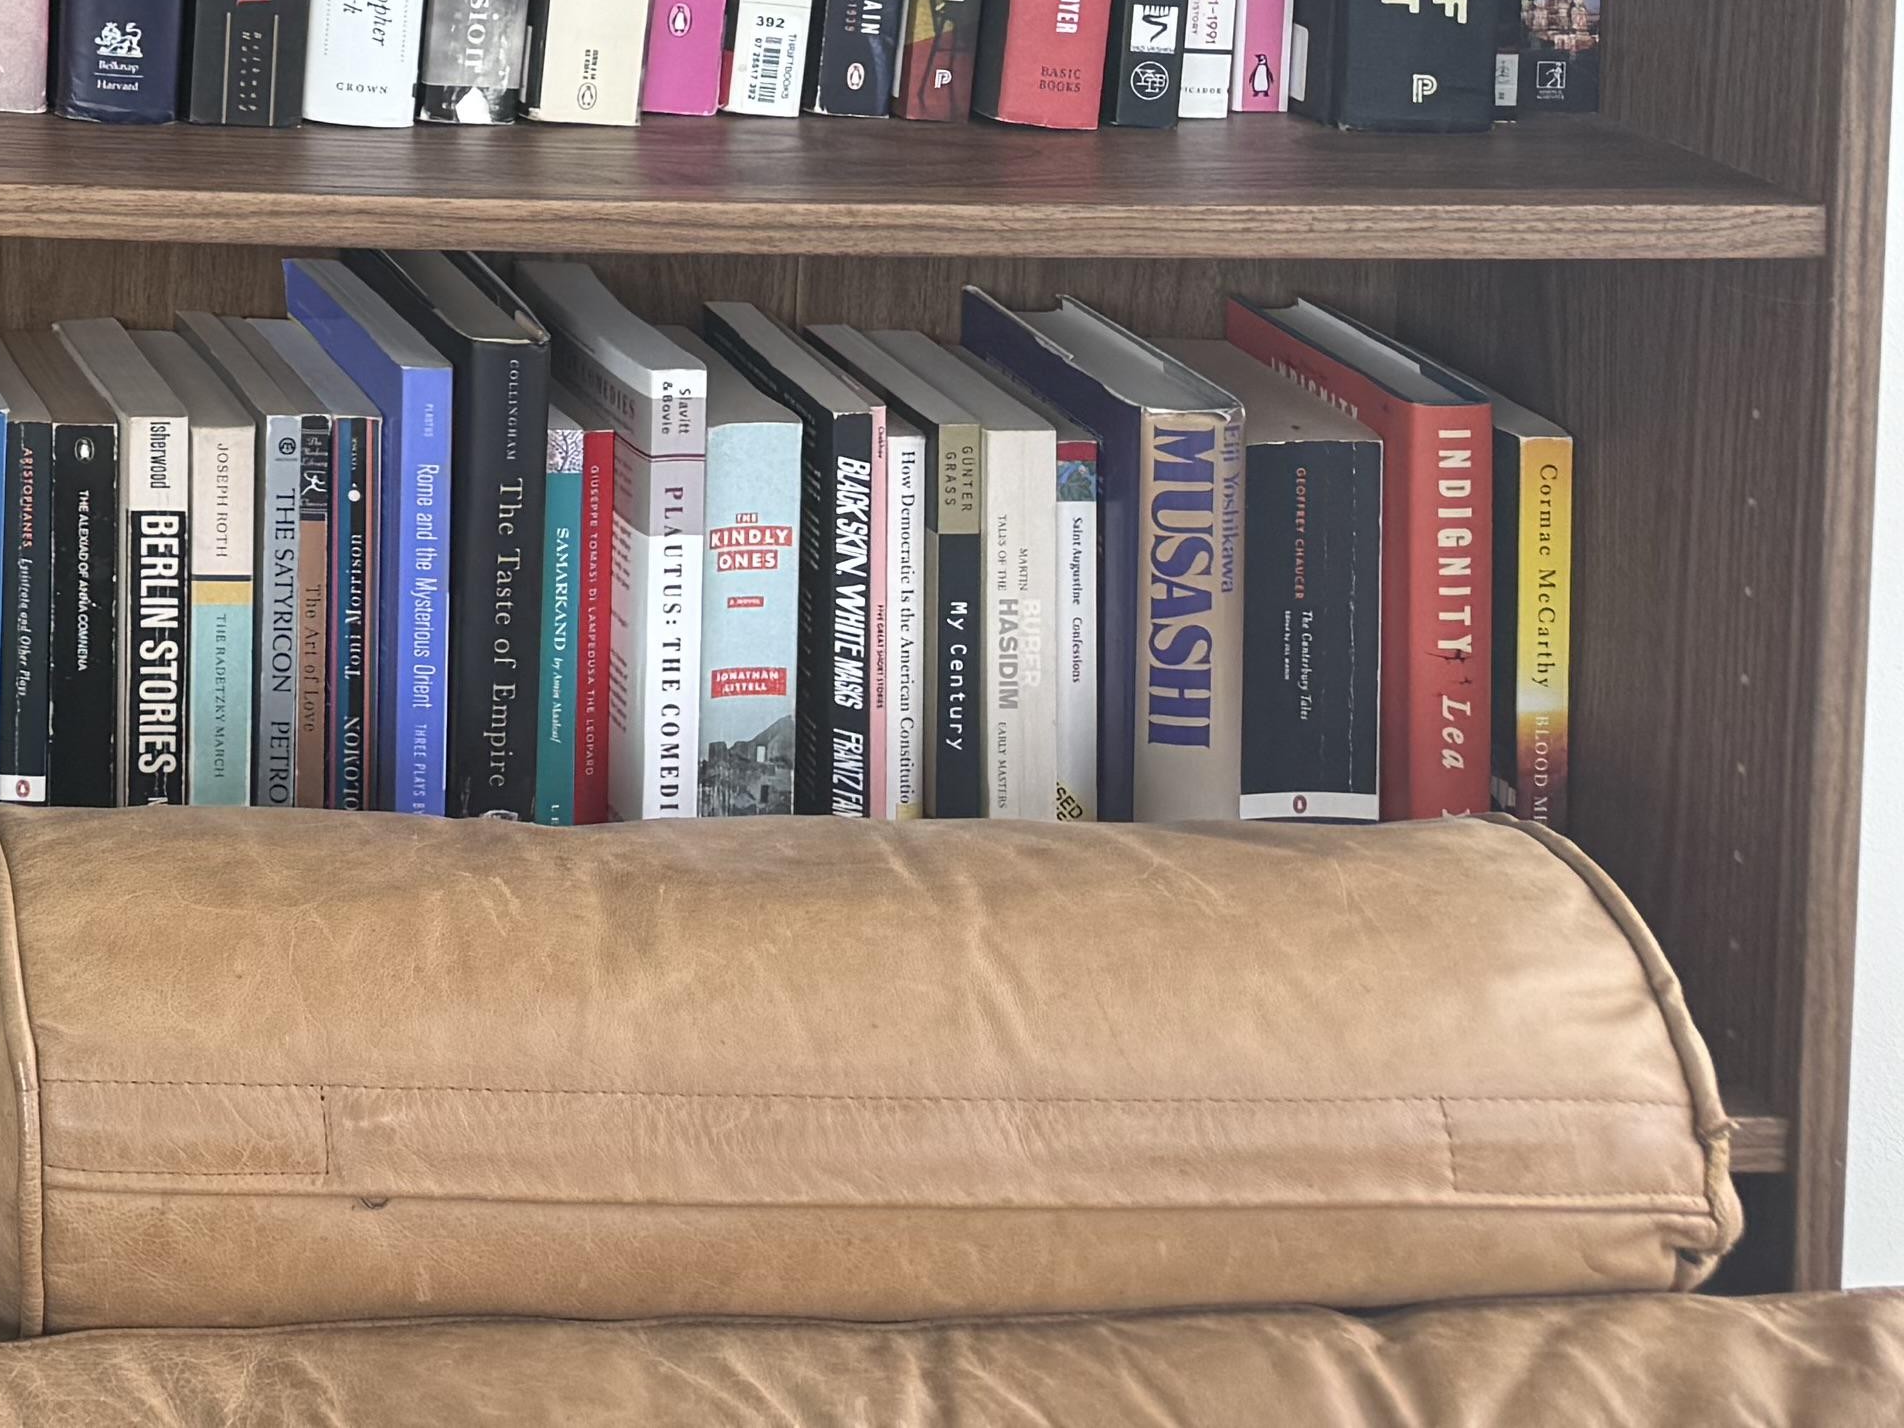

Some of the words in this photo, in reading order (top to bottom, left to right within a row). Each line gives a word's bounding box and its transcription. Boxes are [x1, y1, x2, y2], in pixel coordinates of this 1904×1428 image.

[755, 15, 786, 29] 392
[216, 443, 229, 508] JOSEPH
[216, 513, 228, 558] ROTH
[709, 525, 793, 550] KINDLY
[716, 548, 780, 571] ONES
[1435, 427, 1473, 658] INDIGNITY
[140, 514, 180, 629] BERLIN
[1146, 424, 1217, 751] MUSASHI
[947, 601, 968, 631] My
[138, 640, 179, 775] STORIES
[946, 643, 966, 751] Century
